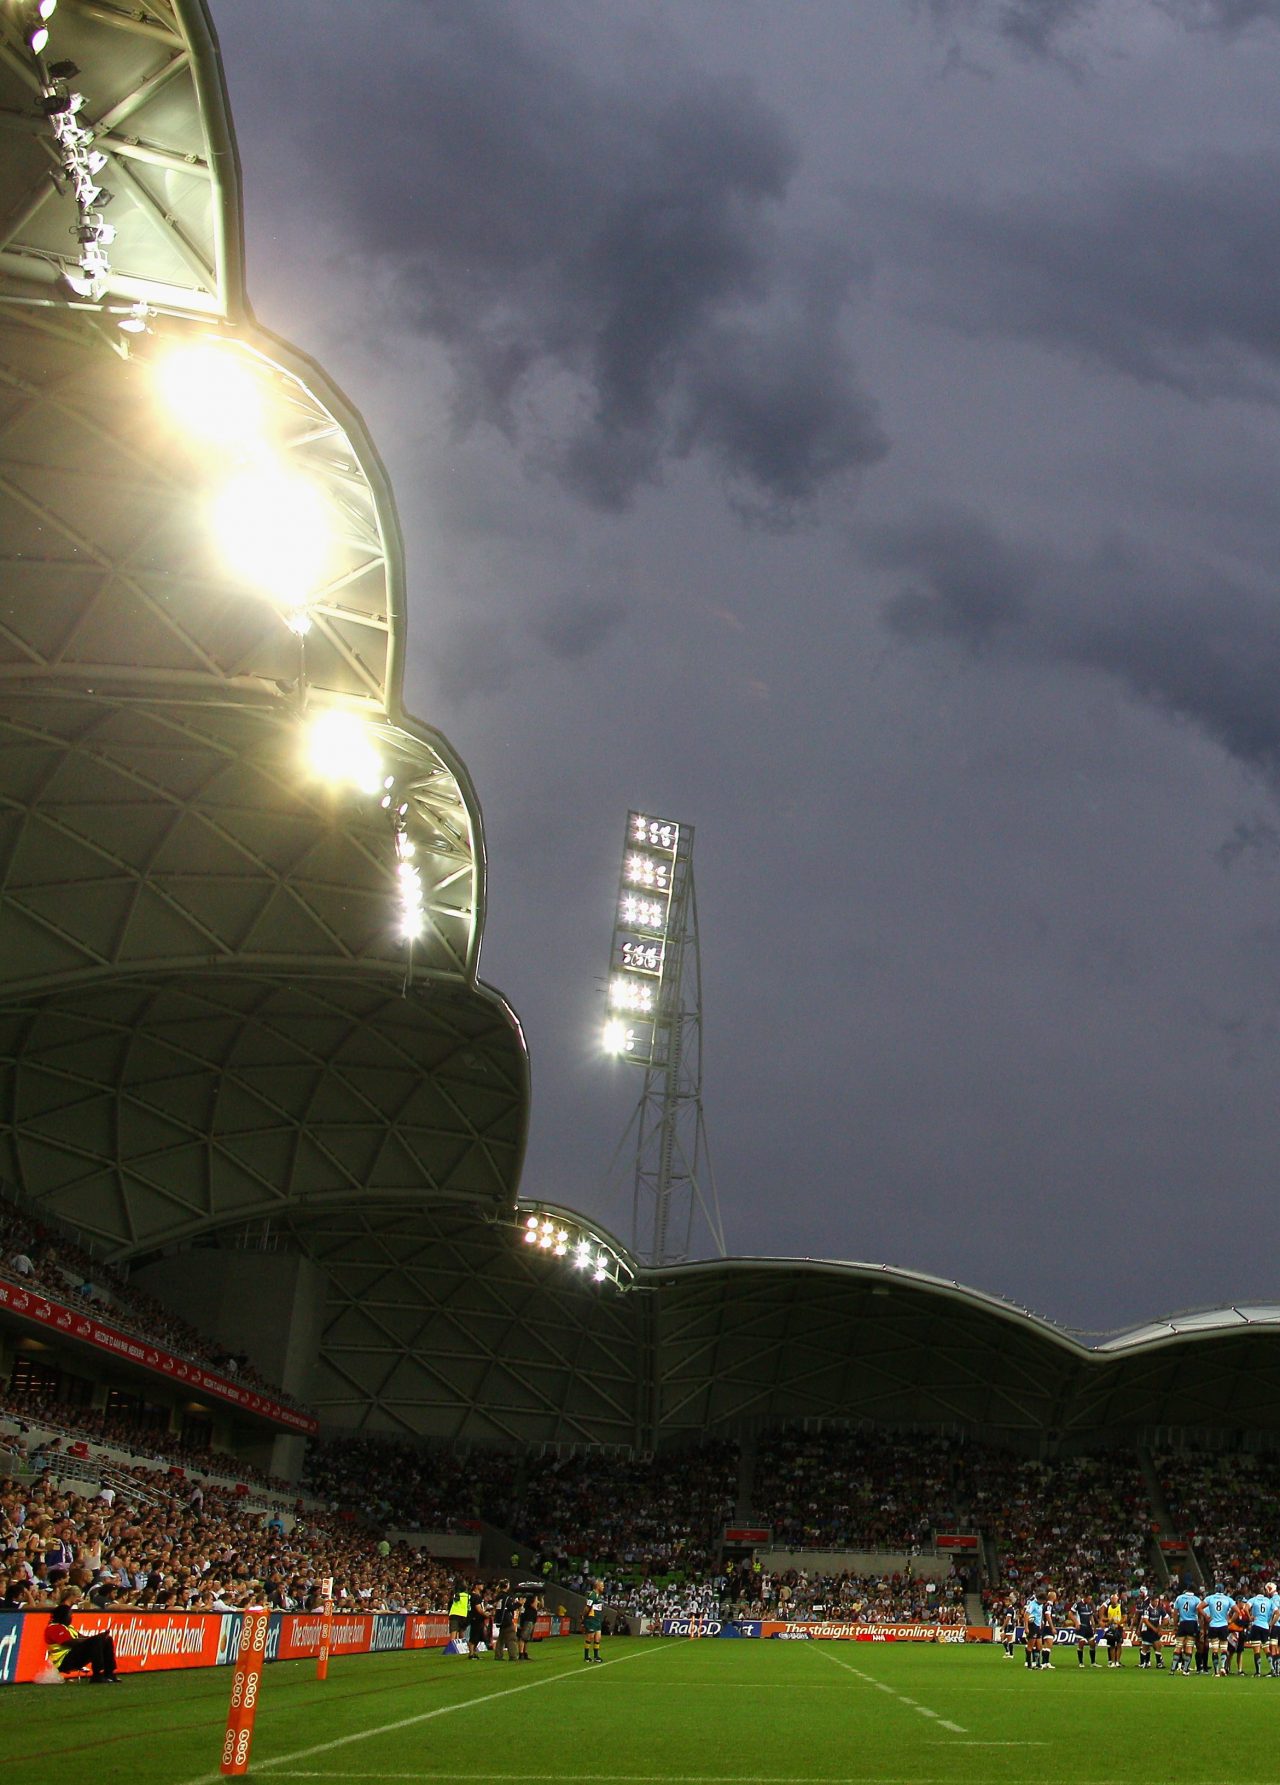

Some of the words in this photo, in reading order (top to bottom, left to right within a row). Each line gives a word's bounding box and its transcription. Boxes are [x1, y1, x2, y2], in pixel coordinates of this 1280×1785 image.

[1215, 1600, 1223, 1611] 8
[116, 1617, 153, 1667] talking
[151, 1617, 182, 1656] online
[181, 1617, 205, 1654] bank
[241, 1615, 254, 1651] TNT
[252, 1615, 268, 1652] TNT
[785, 1623, 807, 1633] The
[809, 1624, 856, 1638] straight
[898, 1625, 935, 1638] online
[935, 1626, 969, 1639] bank
[231, 1672, 245, 1708] TNT
[244, 1672, 259, 1708] TNT
[222, 1729, 236, 1765] TNT
[235, 1729, 250, 1765] TNT
